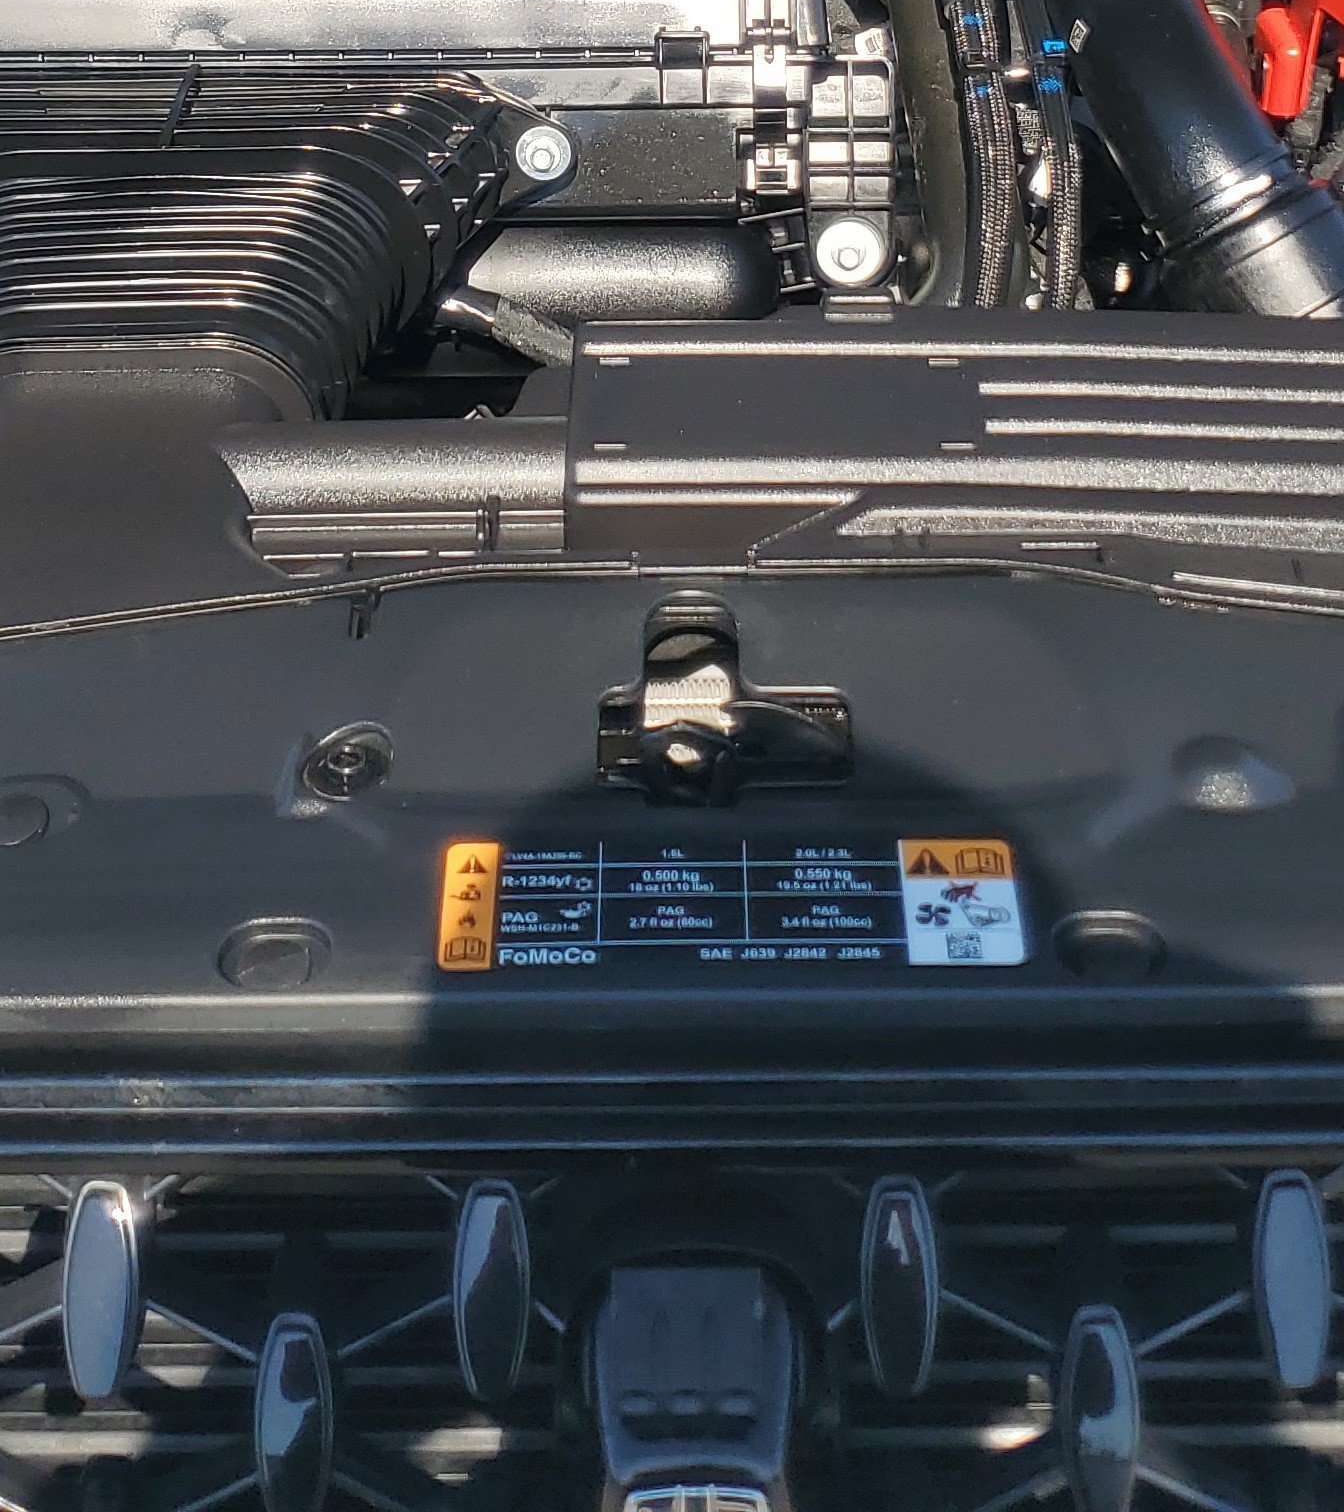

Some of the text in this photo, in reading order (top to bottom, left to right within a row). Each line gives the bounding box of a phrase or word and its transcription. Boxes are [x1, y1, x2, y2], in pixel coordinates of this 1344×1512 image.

[683, 870, 700, 882] kg
[794, 868, 852, 880] 0.550 kg
[502, 875, 572, 887] R-1234yf
[658, 906, 685, 915] PAG
[811, 905, 840, 915] PAG
[502, 911, 539, 923] PAG
[629, 917, 646, 928] 2.7
[660, 919, 674, 928] oz
[812, 918, 826, 927] oz
[829, 916, 872, 928] (100cc)
[499, 947, 596, 965] FoMoCo
[700, 948, 732, 960] SAE
[784, 947, 827, 960] J2842
[837, 946, 881, 959] J2845
